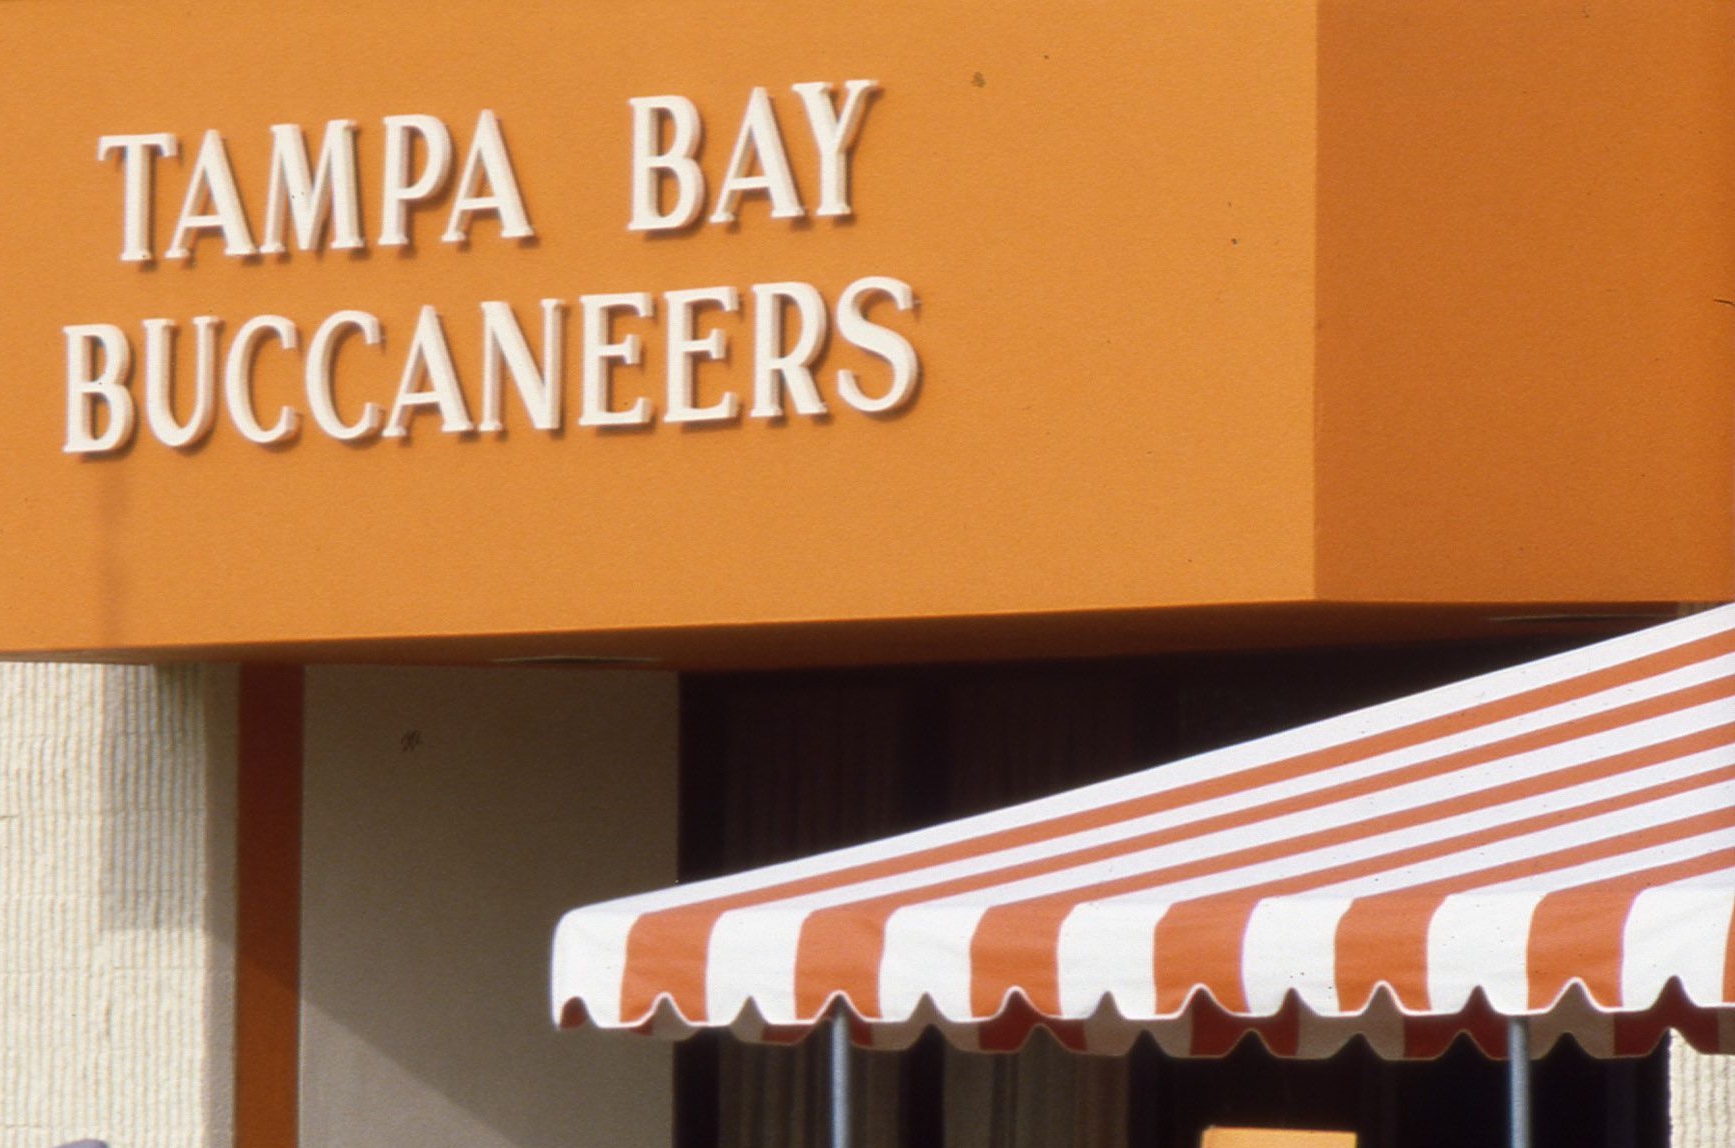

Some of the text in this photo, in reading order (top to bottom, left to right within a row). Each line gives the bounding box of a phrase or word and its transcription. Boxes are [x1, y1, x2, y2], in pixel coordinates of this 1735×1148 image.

[98, 79, 879, 262] TAMPA BAY
[63, 275, 921, 455] BUCCANEERS
